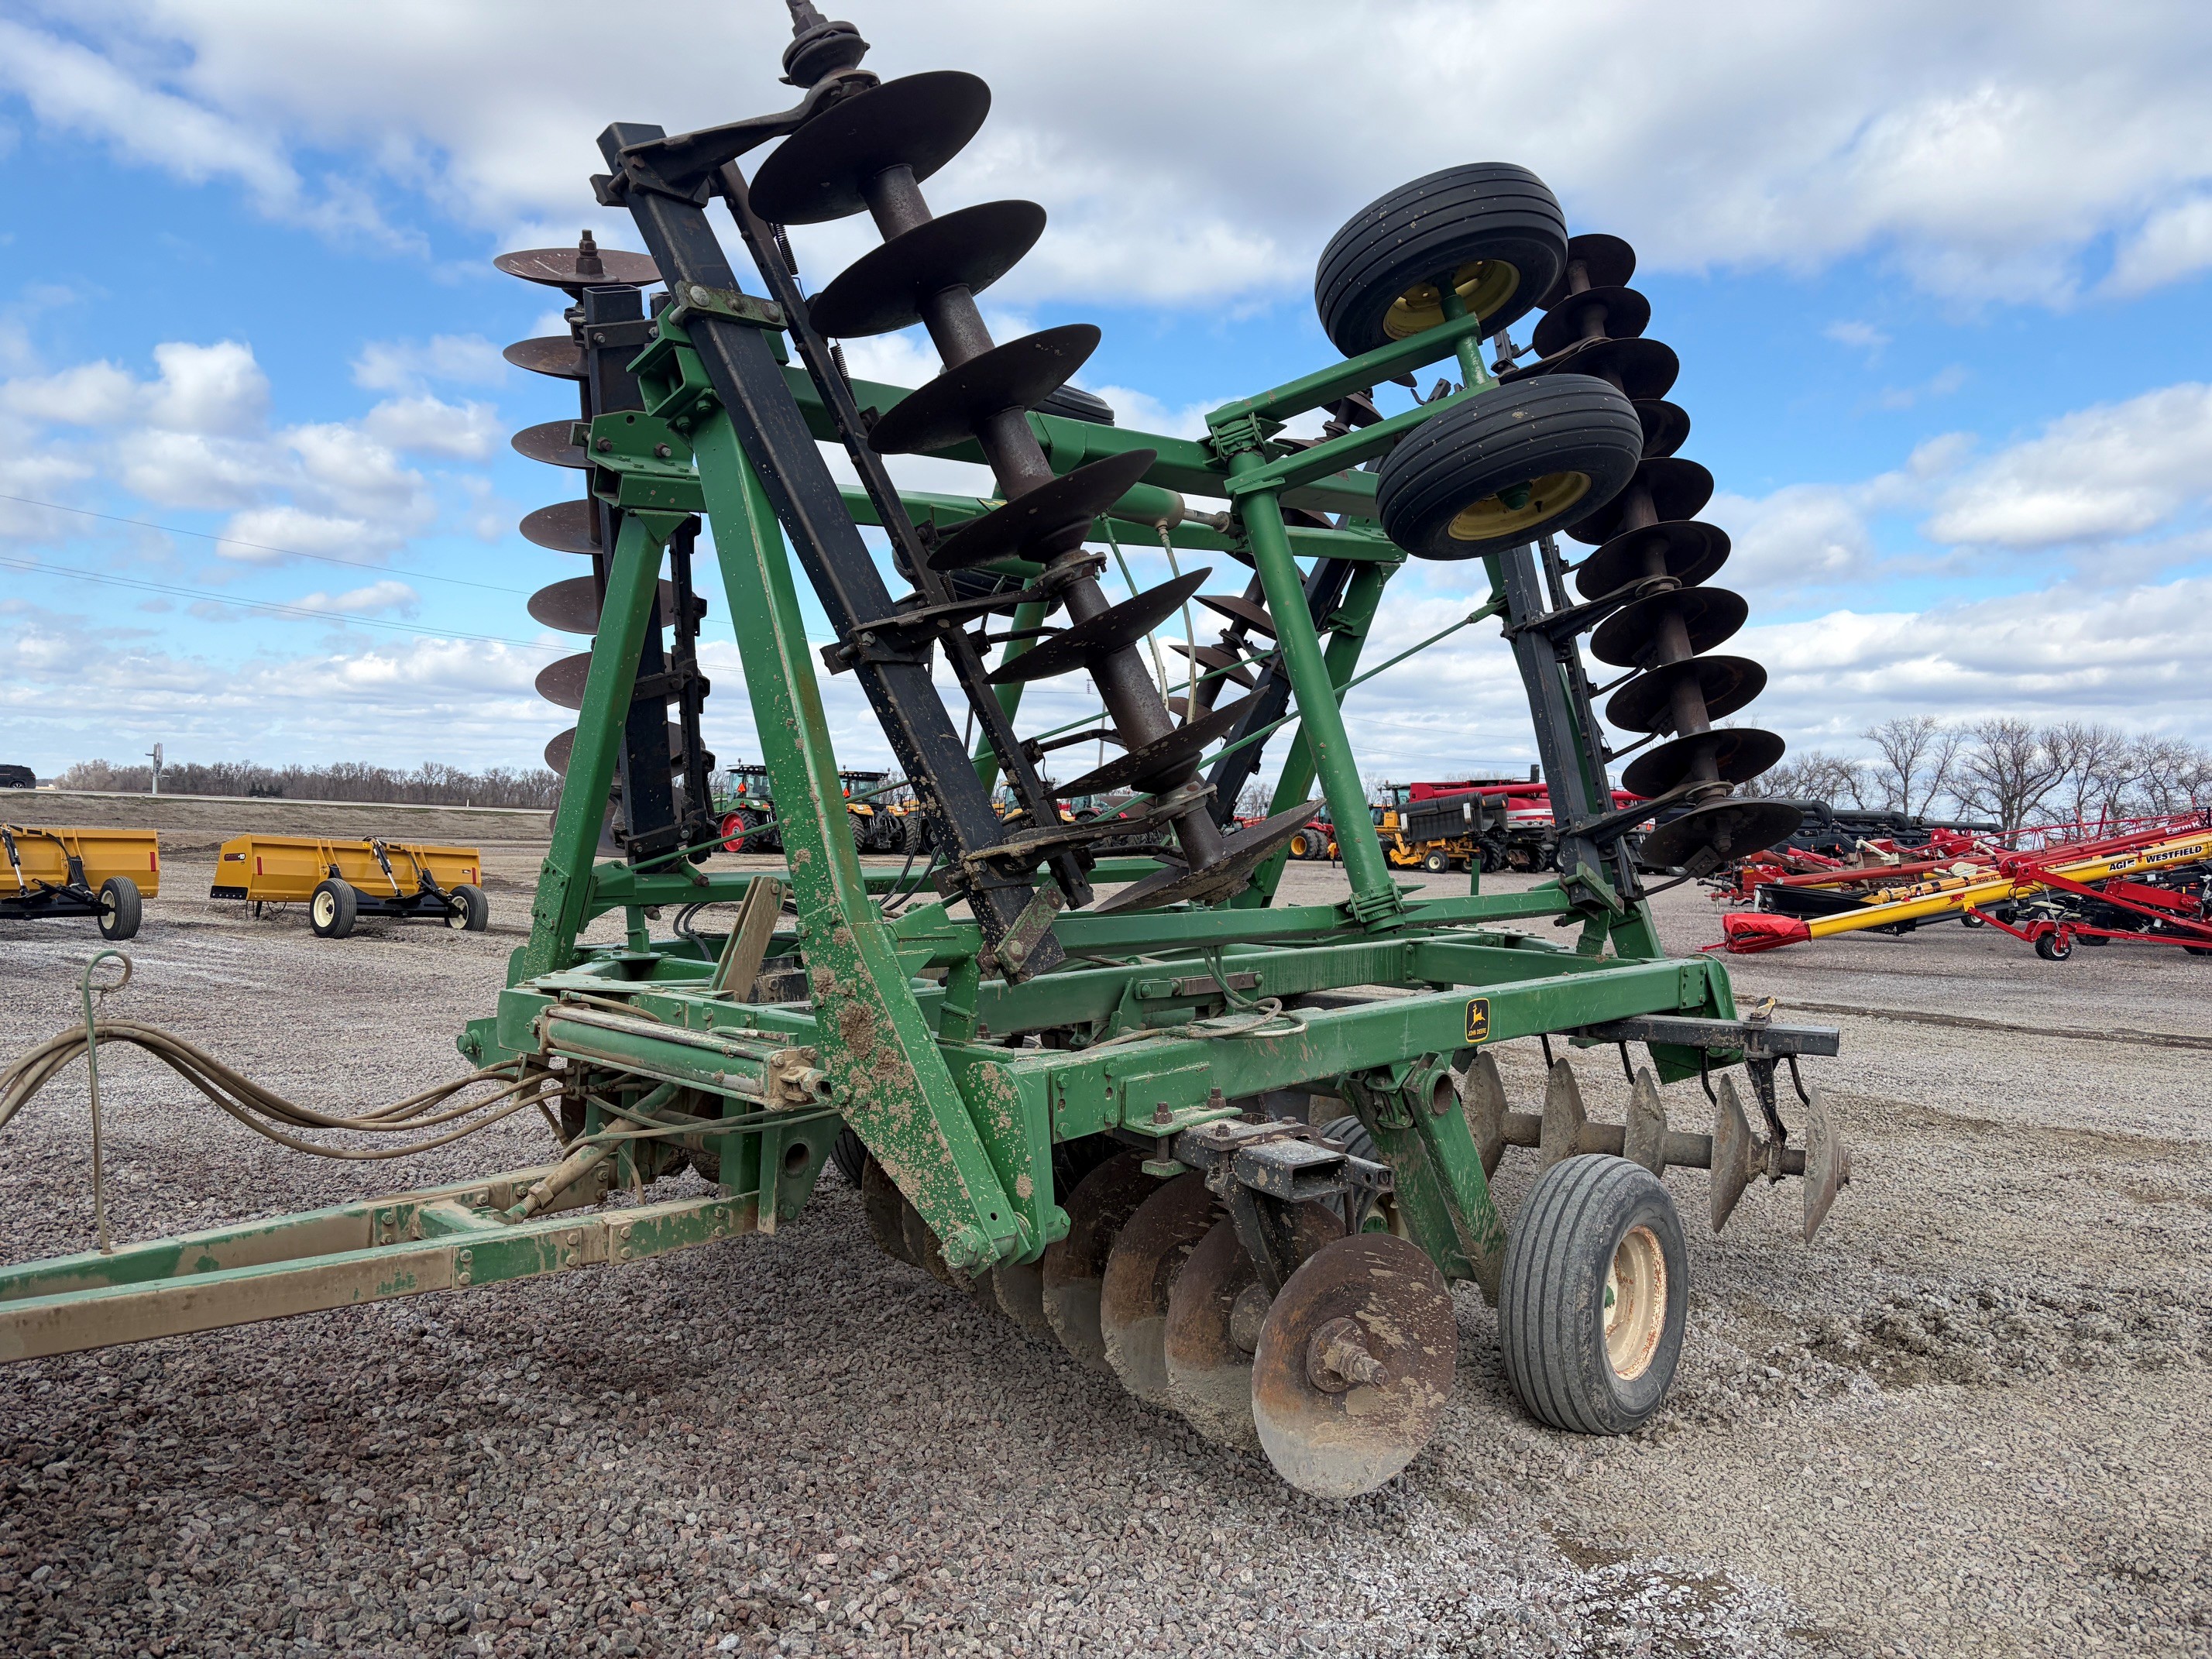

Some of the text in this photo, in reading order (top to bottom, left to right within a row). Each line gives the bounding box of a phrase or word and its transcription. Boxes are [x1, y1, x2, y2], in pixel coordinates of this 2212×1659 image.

[2165, 823, 2192, 834] Farm
[2108, 860, 2127, 871] AGI
[2145, 845, 2203, 864] WESTFIELD
